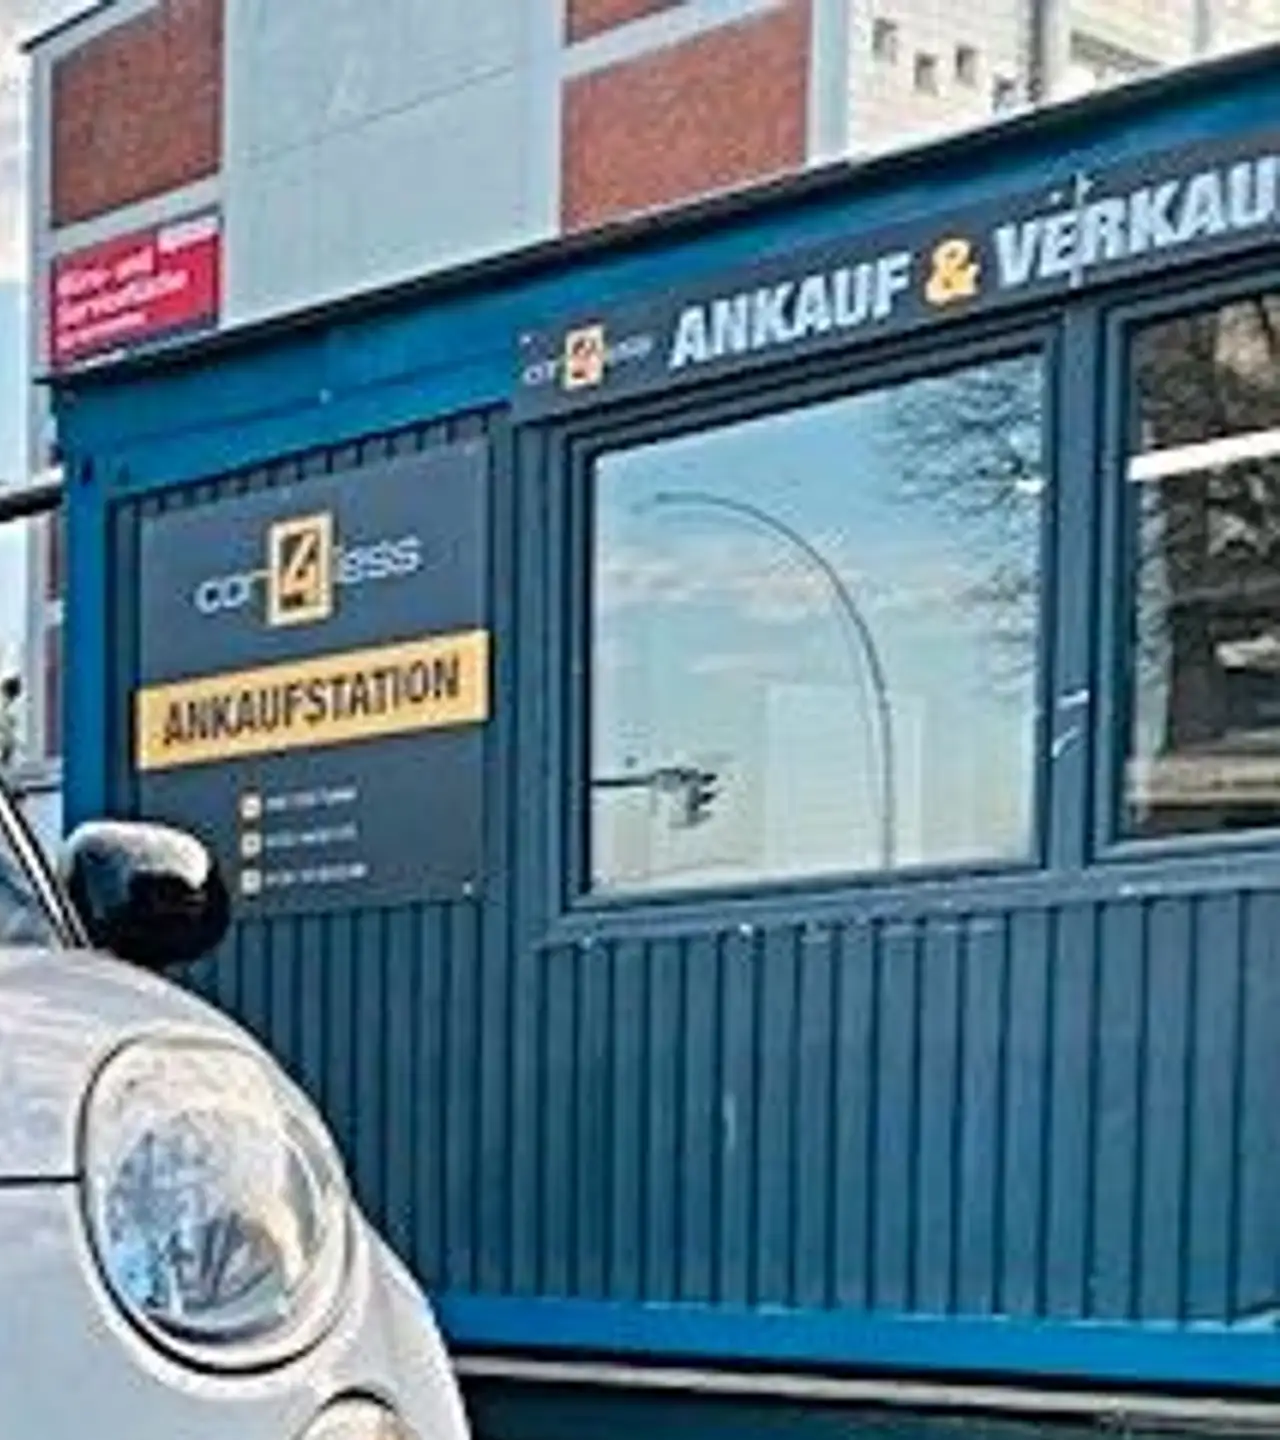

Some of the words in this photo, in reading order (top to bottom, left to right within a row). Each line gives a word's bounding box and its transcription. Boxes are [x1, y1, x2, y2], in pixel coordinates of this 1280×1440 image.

[669, 251, 912, 369] ANKAUF
[924, 238, 981, 305] &
[162, 650, 462, 747] ANKAUFSTATION
